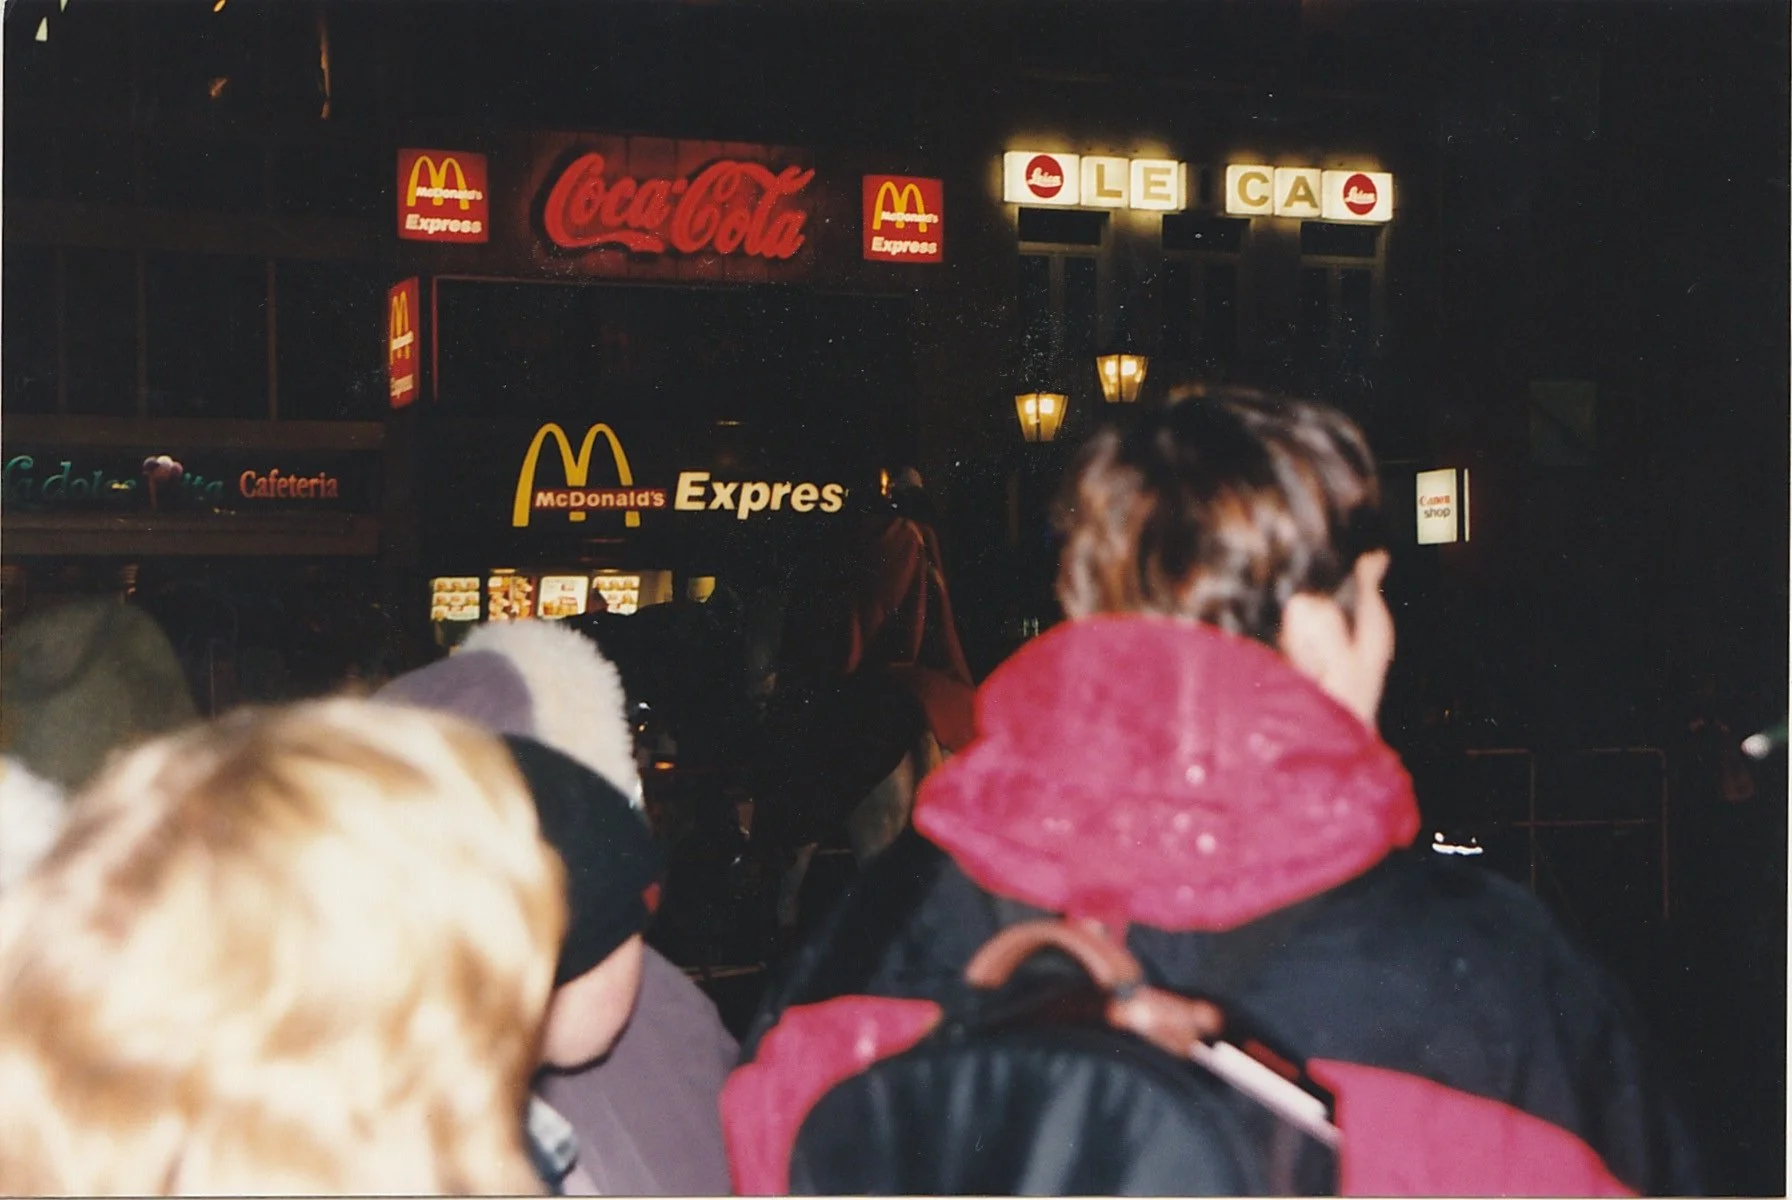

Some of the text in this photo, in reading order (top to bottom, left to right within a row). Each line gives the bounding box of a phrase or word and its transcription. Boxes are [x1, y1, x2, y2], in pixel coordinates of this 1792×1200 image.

[543, 152, 815, 260] Coca-Cola
[405, 213, 482, 234] Express
[871, 236, 937, 256] Express
[239, 468, 339, 499] Cafeteria
[535, 490, 666, 508] McDonald's
[674, 471, 849, 520] Expres
[1424, 507, 1451, 518] shop
